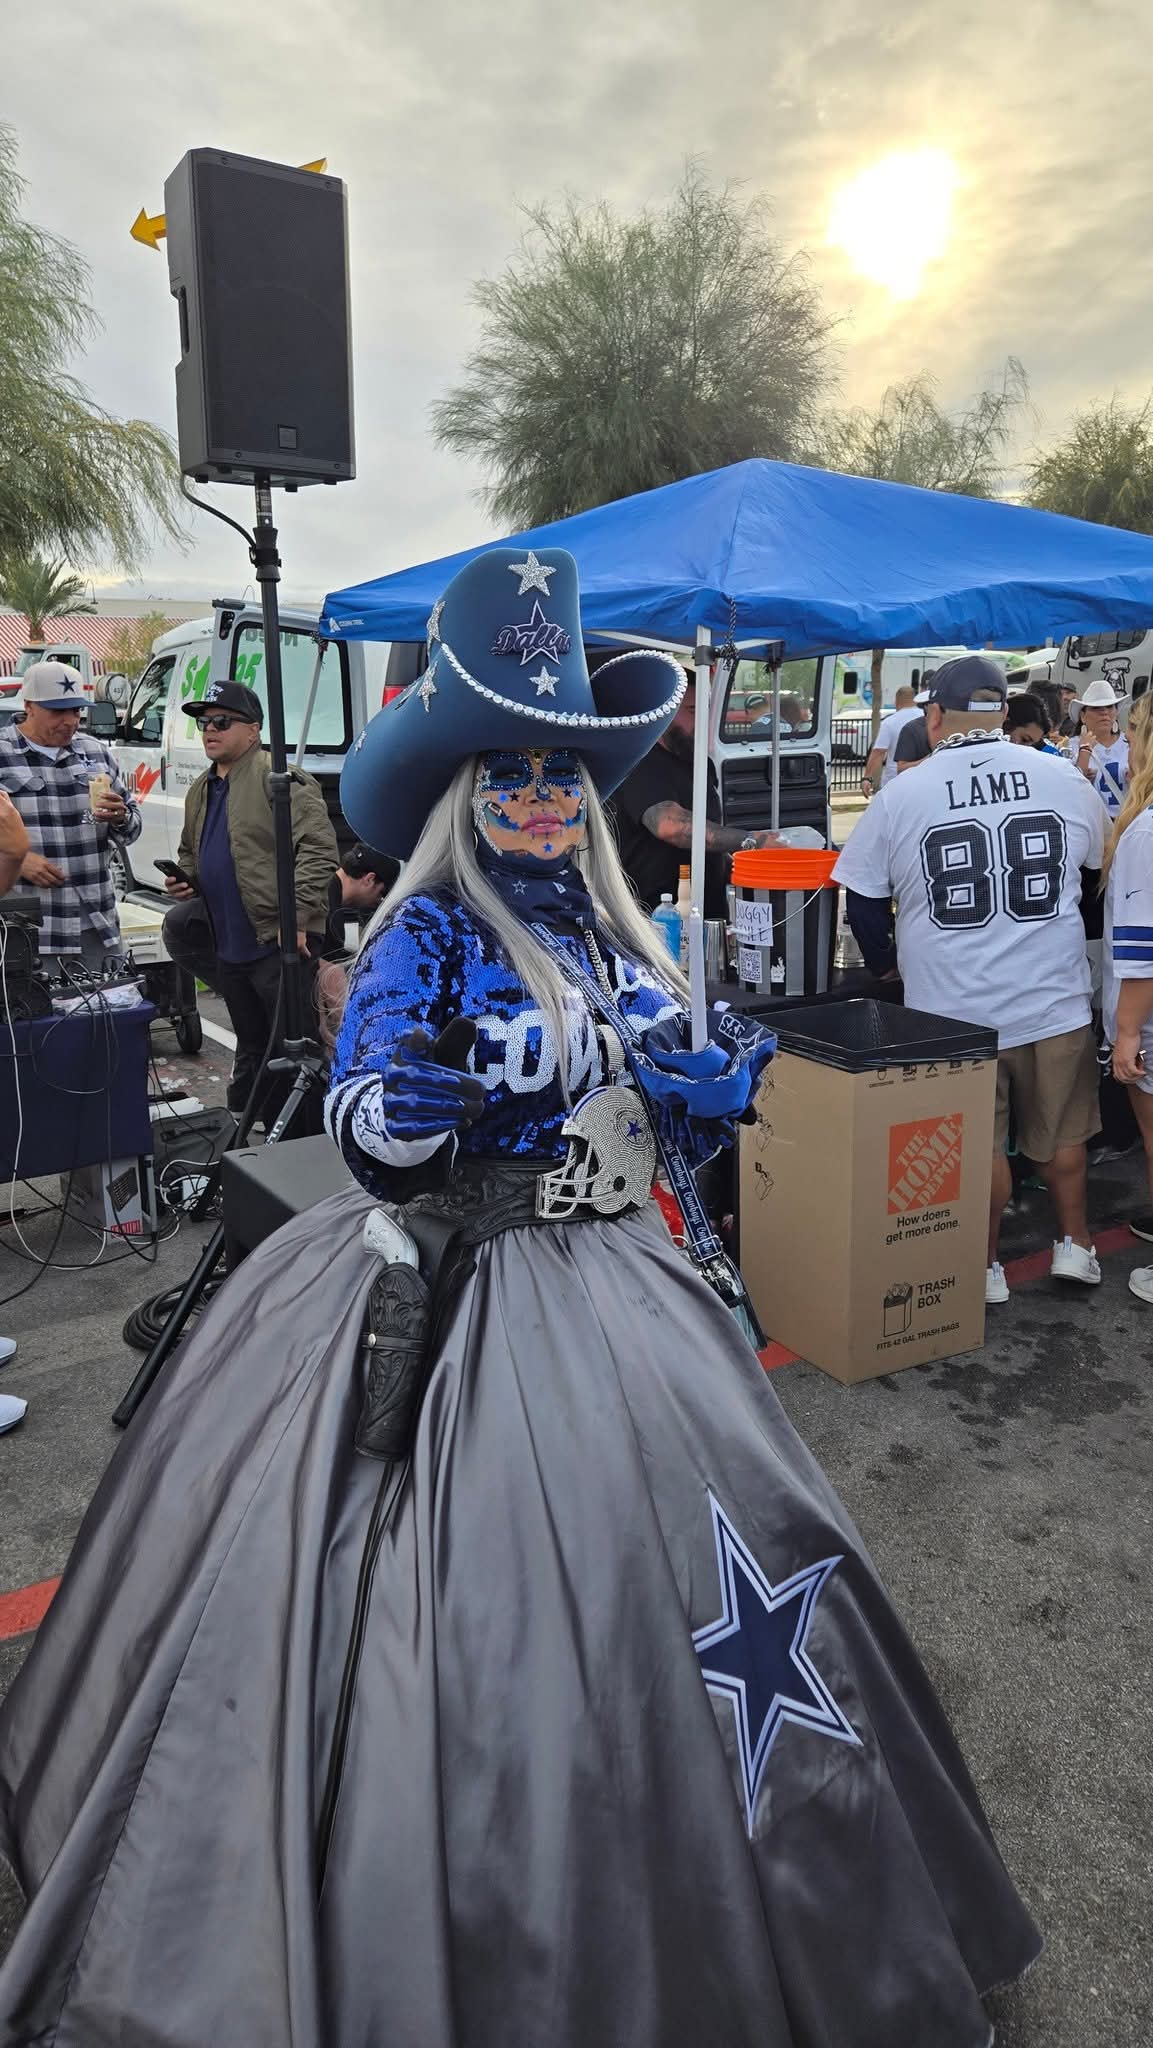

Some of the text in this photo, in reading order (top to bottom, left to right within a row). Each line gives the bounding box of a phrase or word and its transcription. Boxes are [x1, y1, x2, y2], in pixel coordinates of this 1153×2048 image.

[945, 771, 1030, 810] LAMB
[920, 810, 1067, 930] 88
[888, 1112, 962, 1212] HOME
[896, 1130, 928, 1167] THE
[670, 1154, 688, 1191] Cowboys
[683, 1189, 701, 1224] Cowboys
[916, 1145, 961, 1207] DEPOT
[886, 1218, 961, 1246] get more done.
[897, 1208, 951, 1229] How doers
[918, 1276, 956, 1295] TRASH
[918, 1293, 942, 1309] BOX
[876, 1340, 892, 1351] FITS
[917, 1328, 941, 1340] TRASH
[941, 1322, 960, 1333] BAGS
